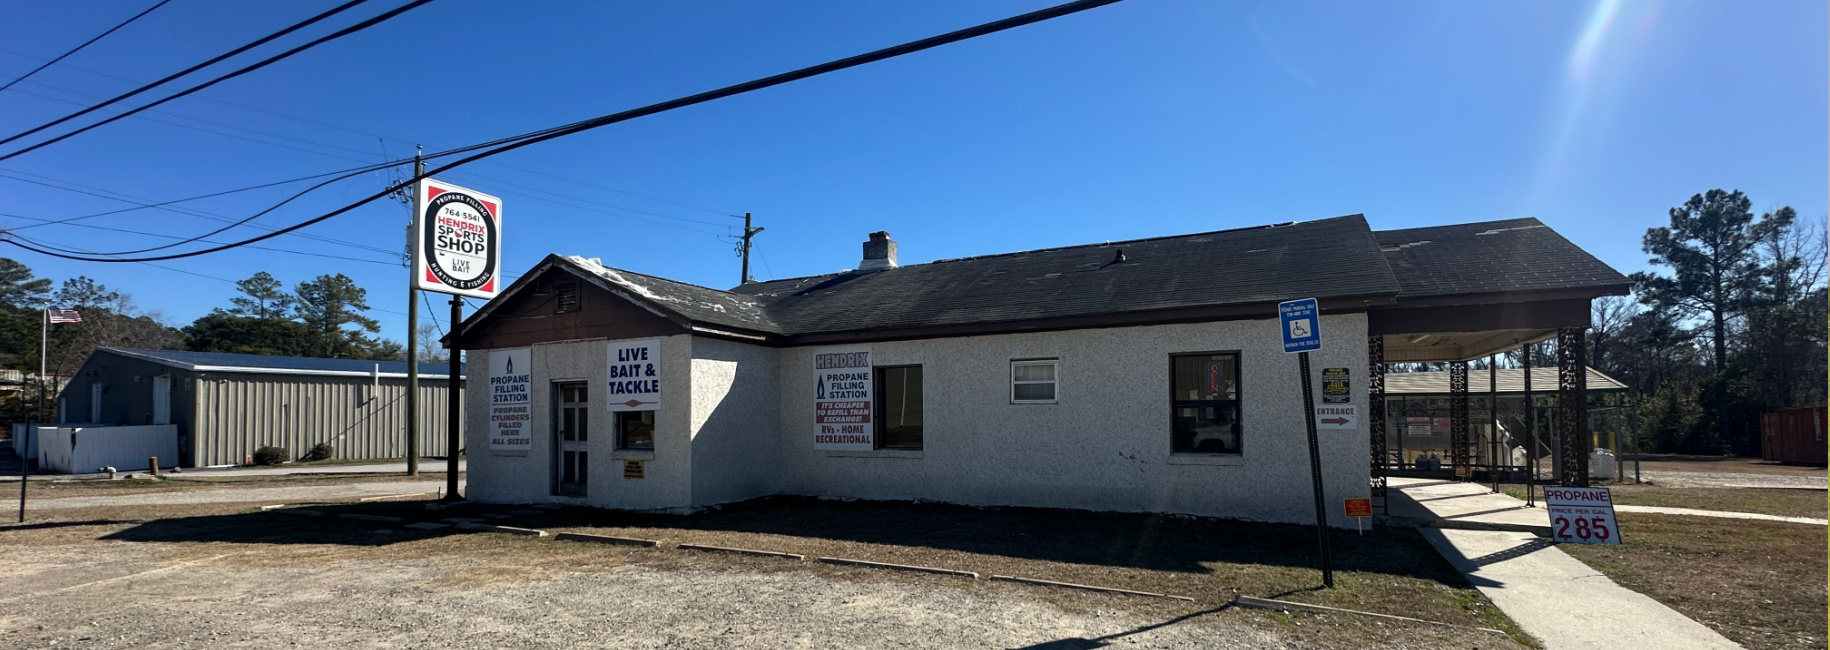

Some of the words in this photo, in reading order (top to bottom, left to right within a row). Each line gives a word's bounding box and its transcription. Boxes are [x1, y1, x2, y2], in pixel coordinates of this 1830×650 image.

[436, 195, 464, 206] PROPANE
[466, 198, 488, 216] FILLING
[445, 208, 480, 222] 764-5541
[438, 216, 485, 234] HENDRIX
[437, 236, 485, 255] SHOP
[452, 258, 470, 266] LIVE
[431, 262, 458, 286] HUNTING
[468, 272, 490, 287] FISHING
[452, 265, 470, 273] BAIT
[618, 347, 648, 362] LIVE
[816, 352, 869, 369] HENDRIX
[610, 364, 641, 378] BAIT
[645, 363, 656, 376] &
[491, 375, 529, 385] PROPANE
[827, 373, 869, 381] PROPANE
[495, 384, 525, 393] FILLING
[609, 380, 659, 394] TACKLE
[832, 382, 864, 390] FILLING
[494, 394, 527, 402] STATION
[830, 390, 867, 399] STATION
[822, 426, 834, 434] RVs
[842, 425, 864, 434] HOME
[816, 435, 870, 444] RECREATIONAL
[1546, 490, 1608, 501] PROPANE
[1555, 517, 1609, 540] 285
